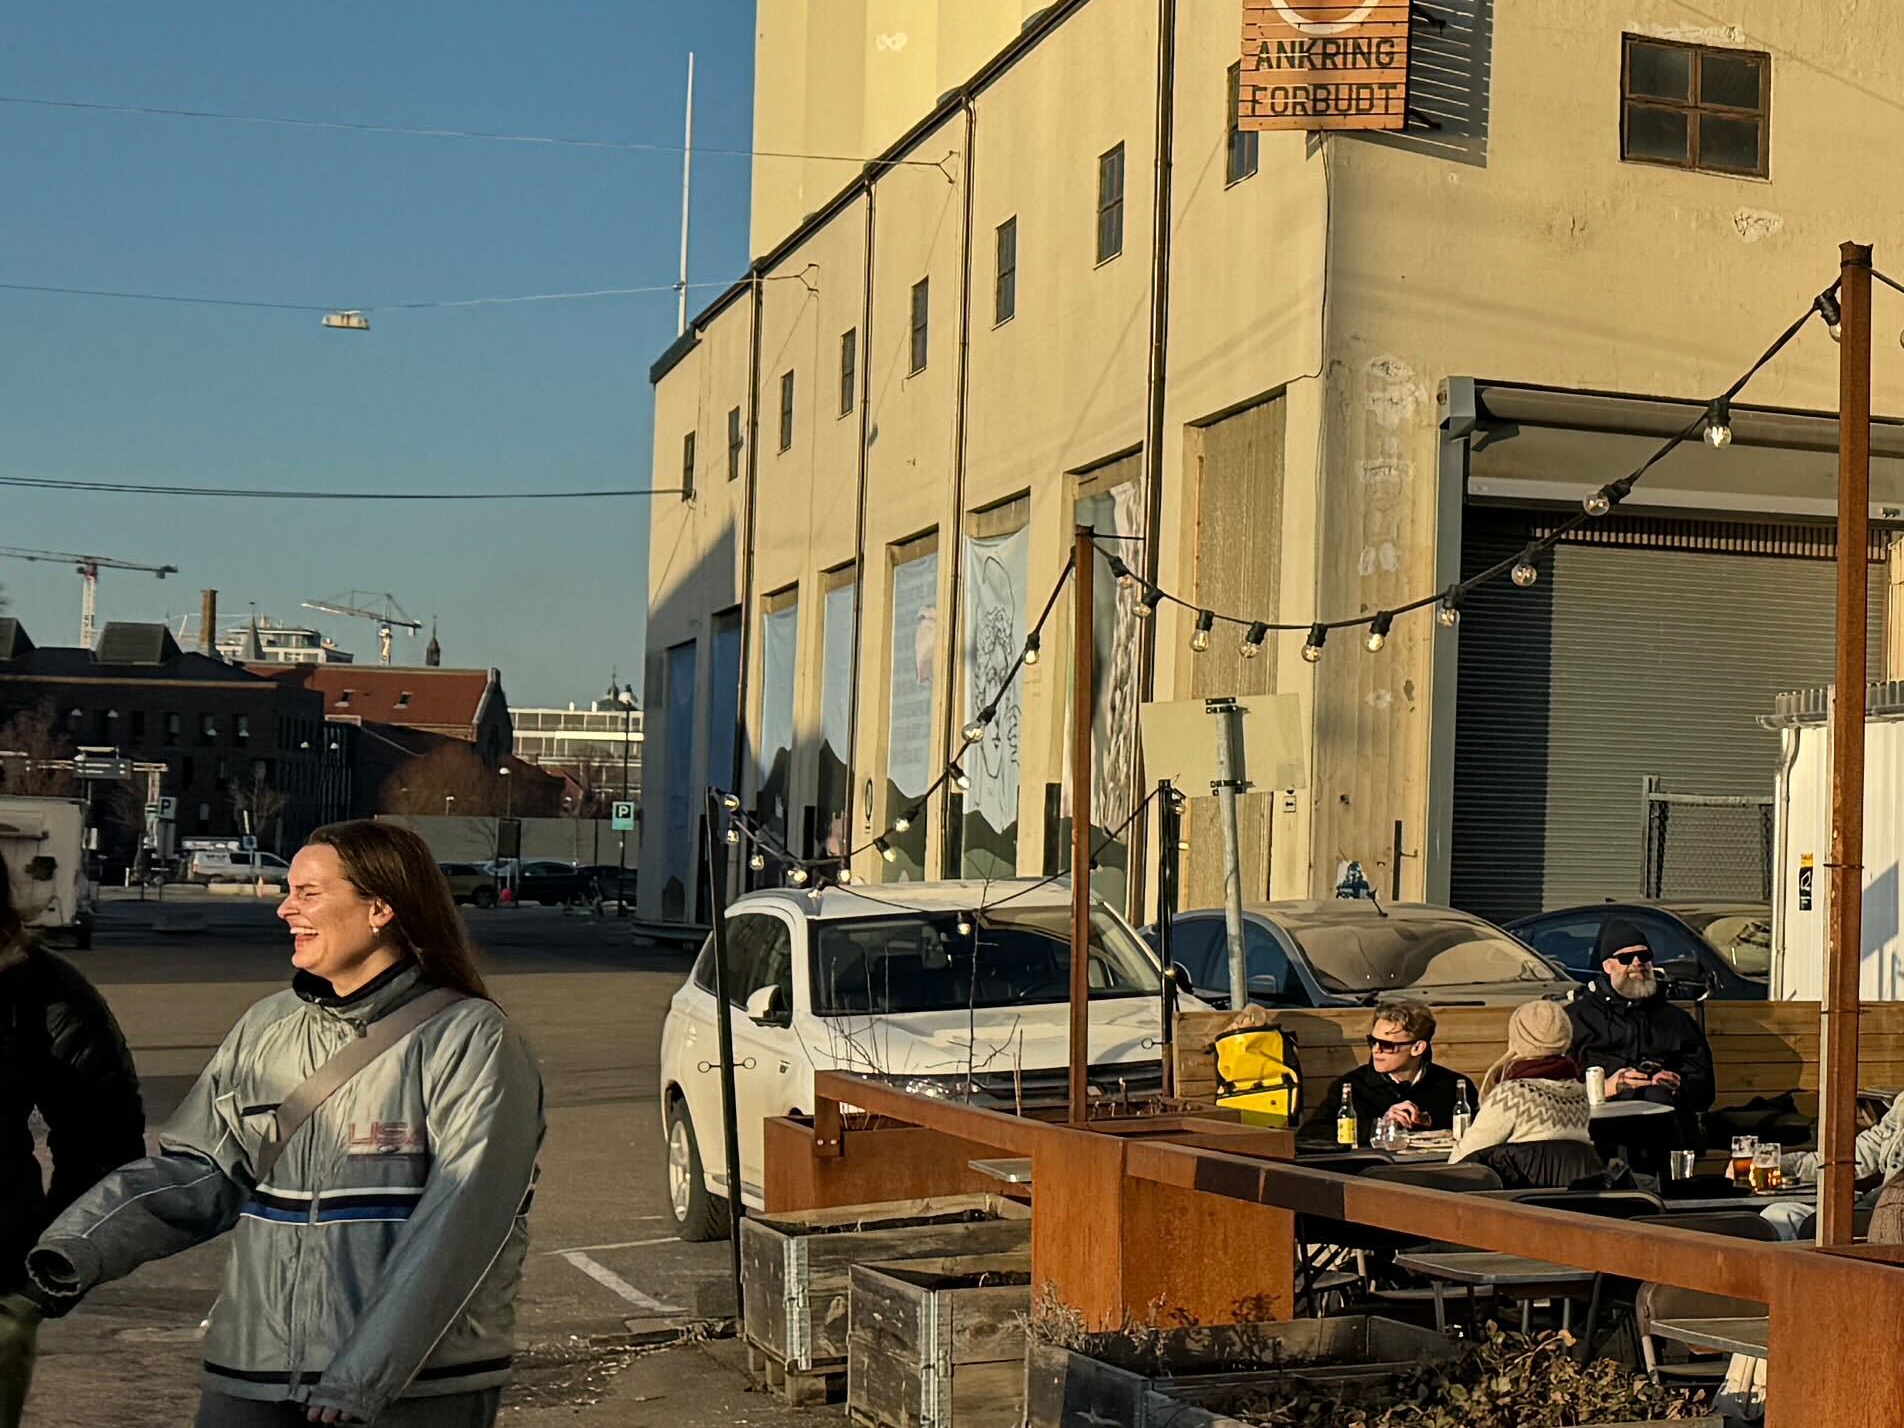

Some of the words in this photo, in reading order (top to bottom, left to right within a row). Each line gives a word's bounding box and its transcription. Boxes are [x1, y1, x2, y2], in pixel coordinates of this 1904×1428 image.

[1255, 39, 1395, 71] ANKRING
[1251, 84, 1398, 116] FORBUDT
[161, 799, 171, 814] P
[618, 805, 629, 818] P
